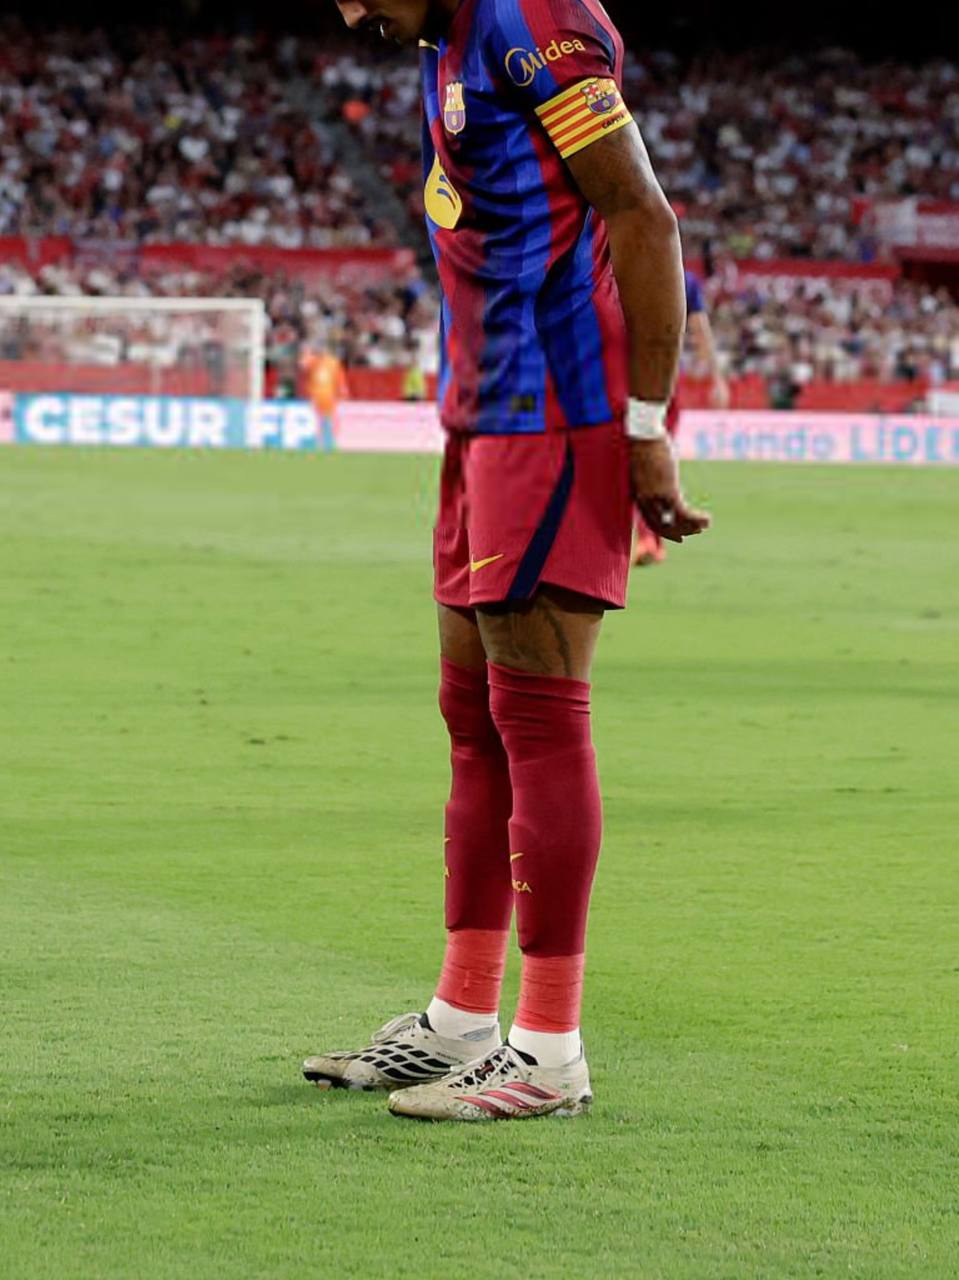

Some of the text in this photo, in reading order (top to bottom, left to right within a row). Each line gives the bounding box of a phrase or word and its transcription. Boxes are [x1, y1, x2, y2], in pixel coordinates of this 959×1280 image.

[504, 36, 586, 87] Midea
[24, 396, 319, 450] CESUR FP
